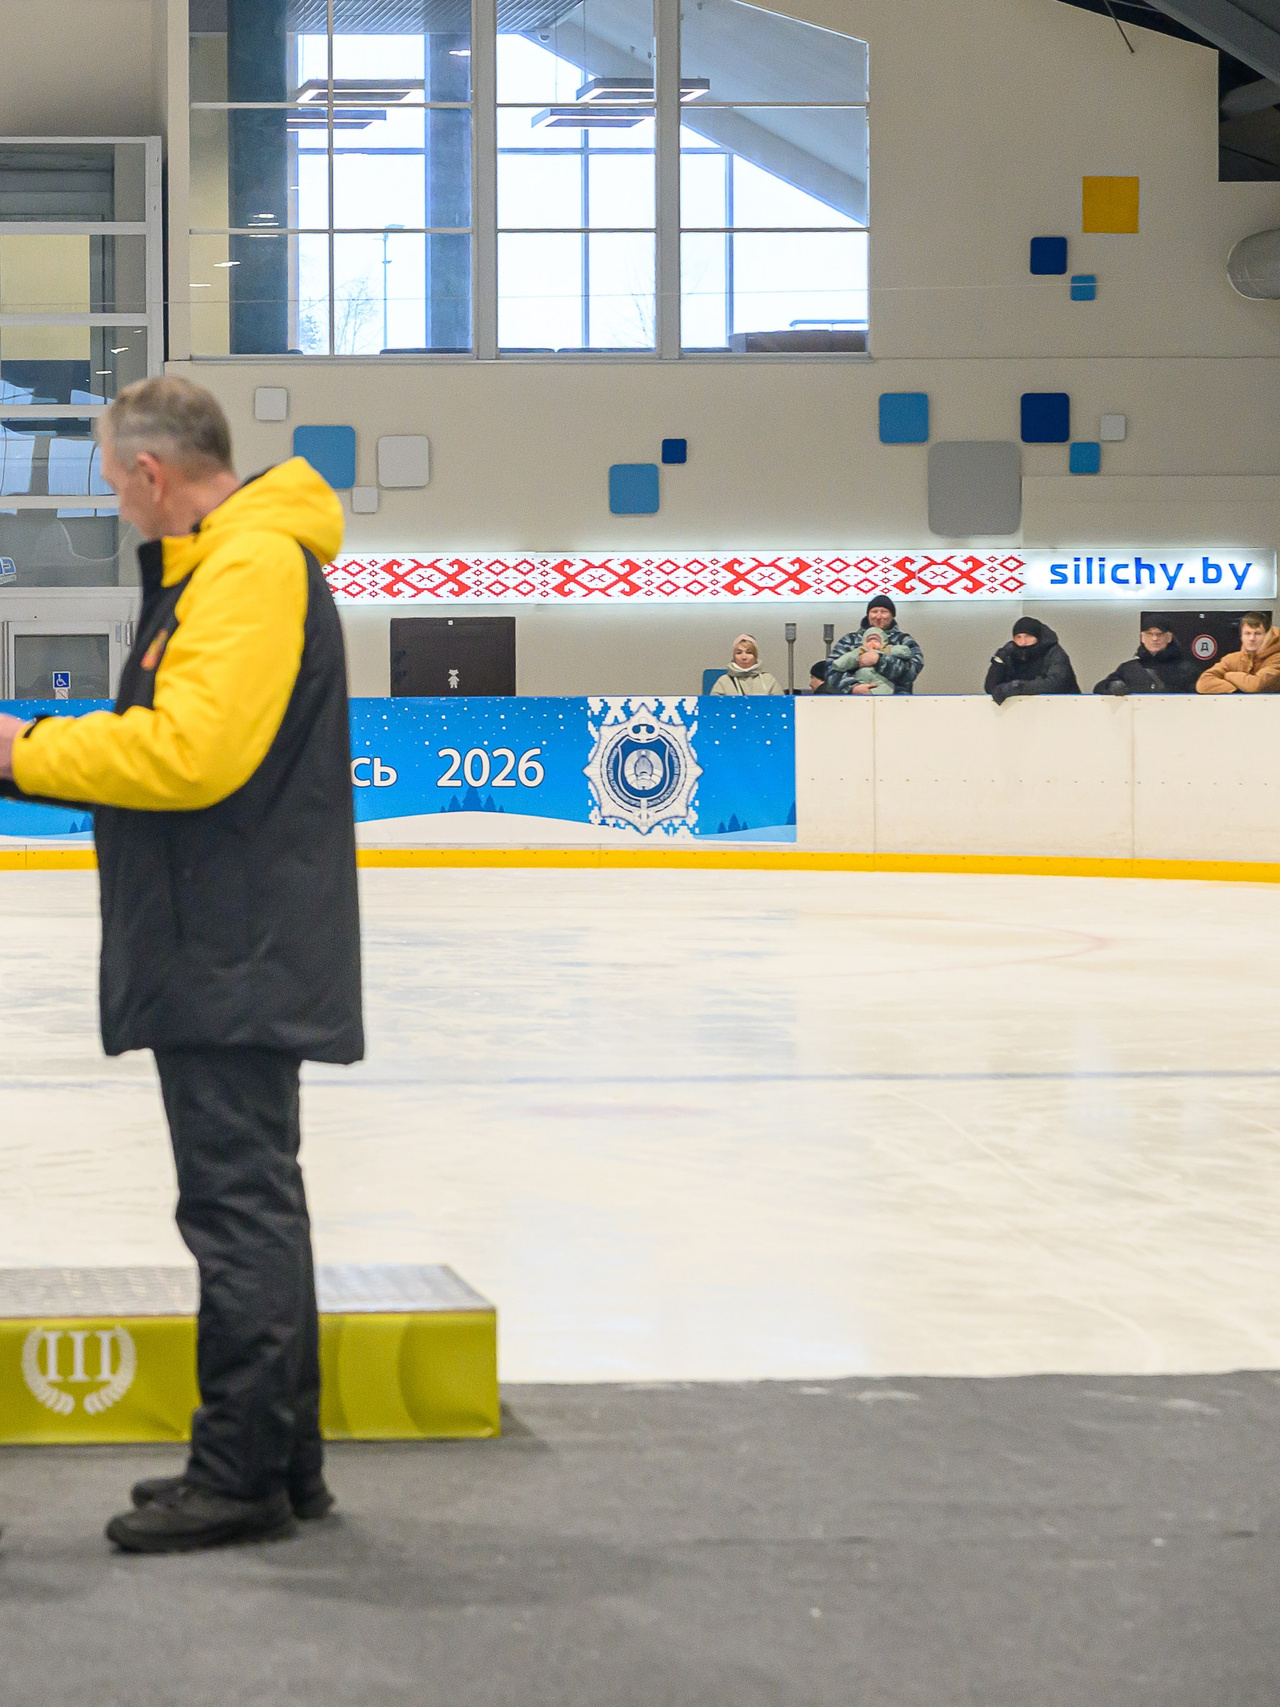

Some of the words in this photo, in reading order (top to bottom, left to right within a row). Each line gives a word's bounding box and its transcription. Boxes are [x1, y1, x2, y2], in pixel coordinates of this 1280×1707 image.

[1050, 557, 1253, 590] silichy.by
[436, 747, 546, 788] 2026
[42, 1329, 116, 1382] III
